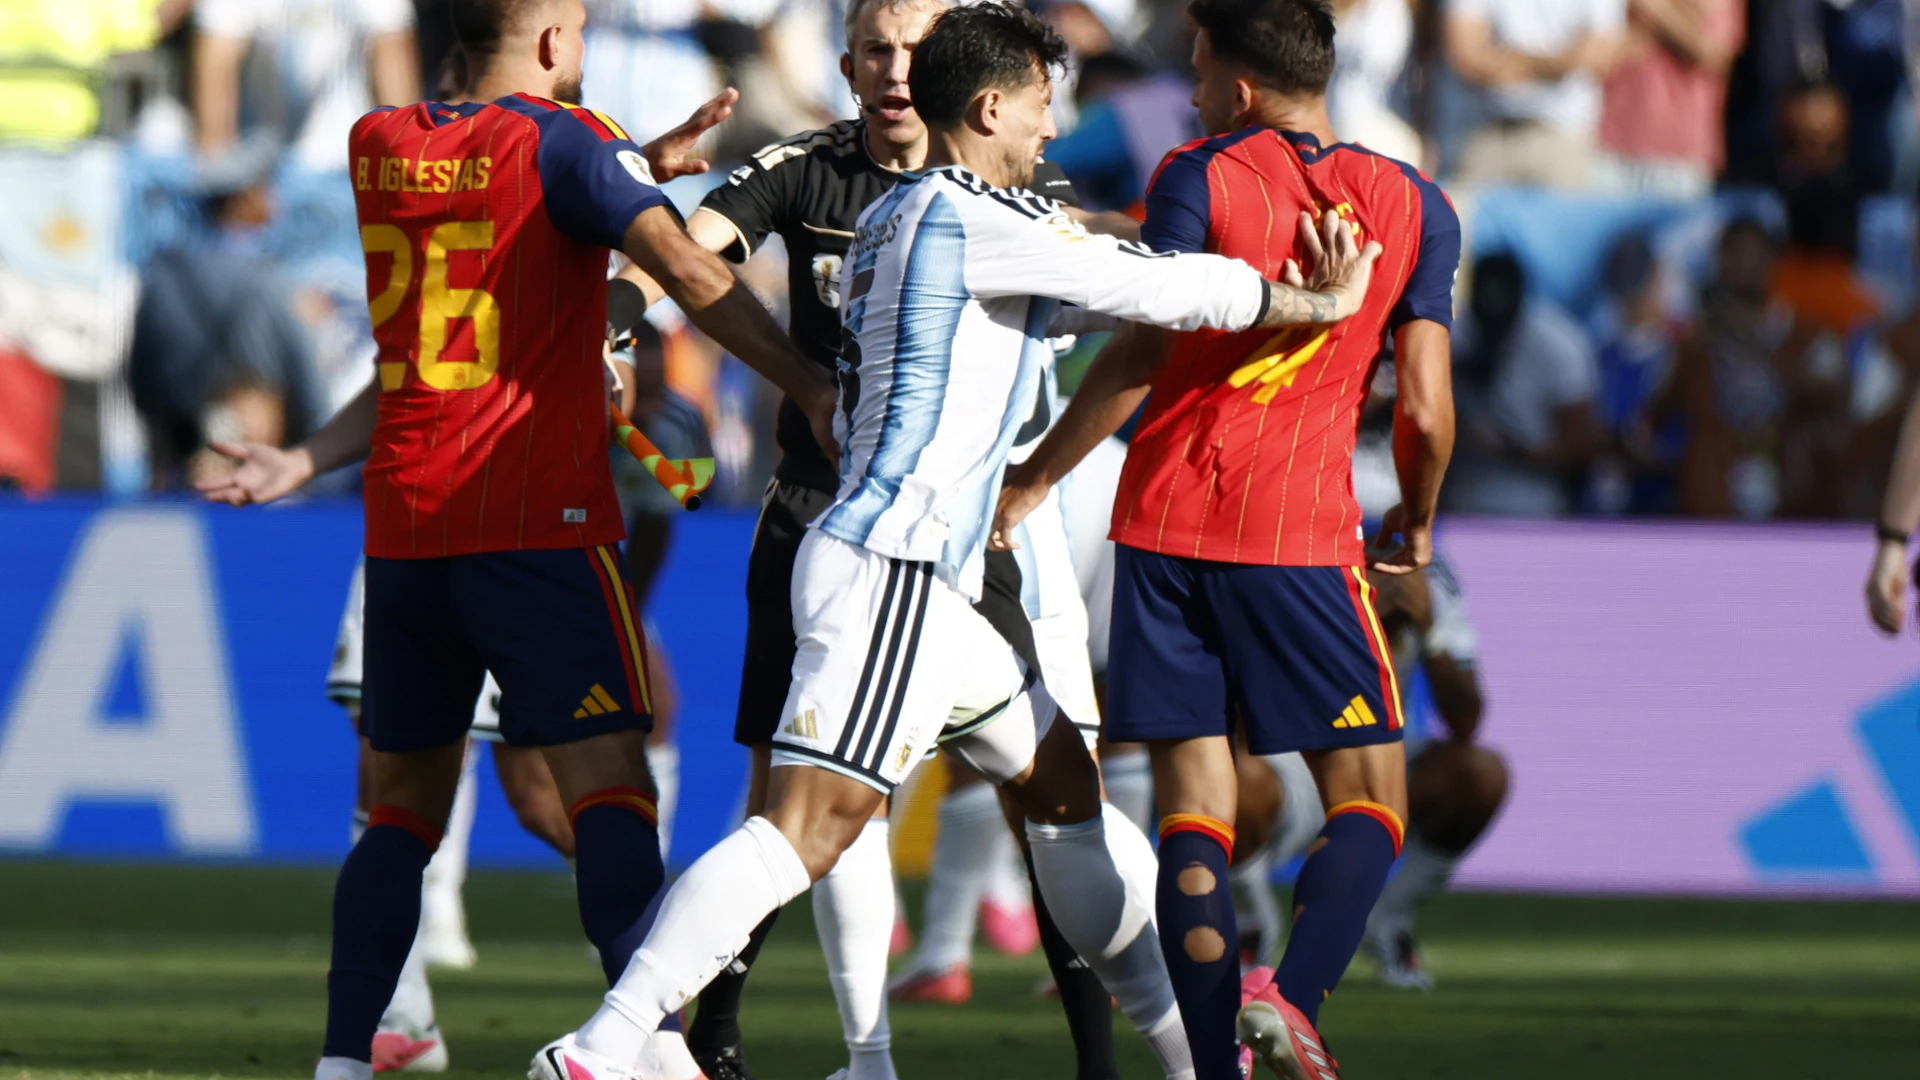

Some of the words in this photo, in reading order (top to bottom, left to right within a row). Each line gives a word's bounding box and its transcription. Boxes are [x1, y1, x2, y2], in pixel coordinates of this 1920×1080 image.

[357, 156, 373, 191] B.
[378, 156, 493, 193] IGLESIAS
[361, 220, 500, 391] 26
[0, 507, 261, 855] A
